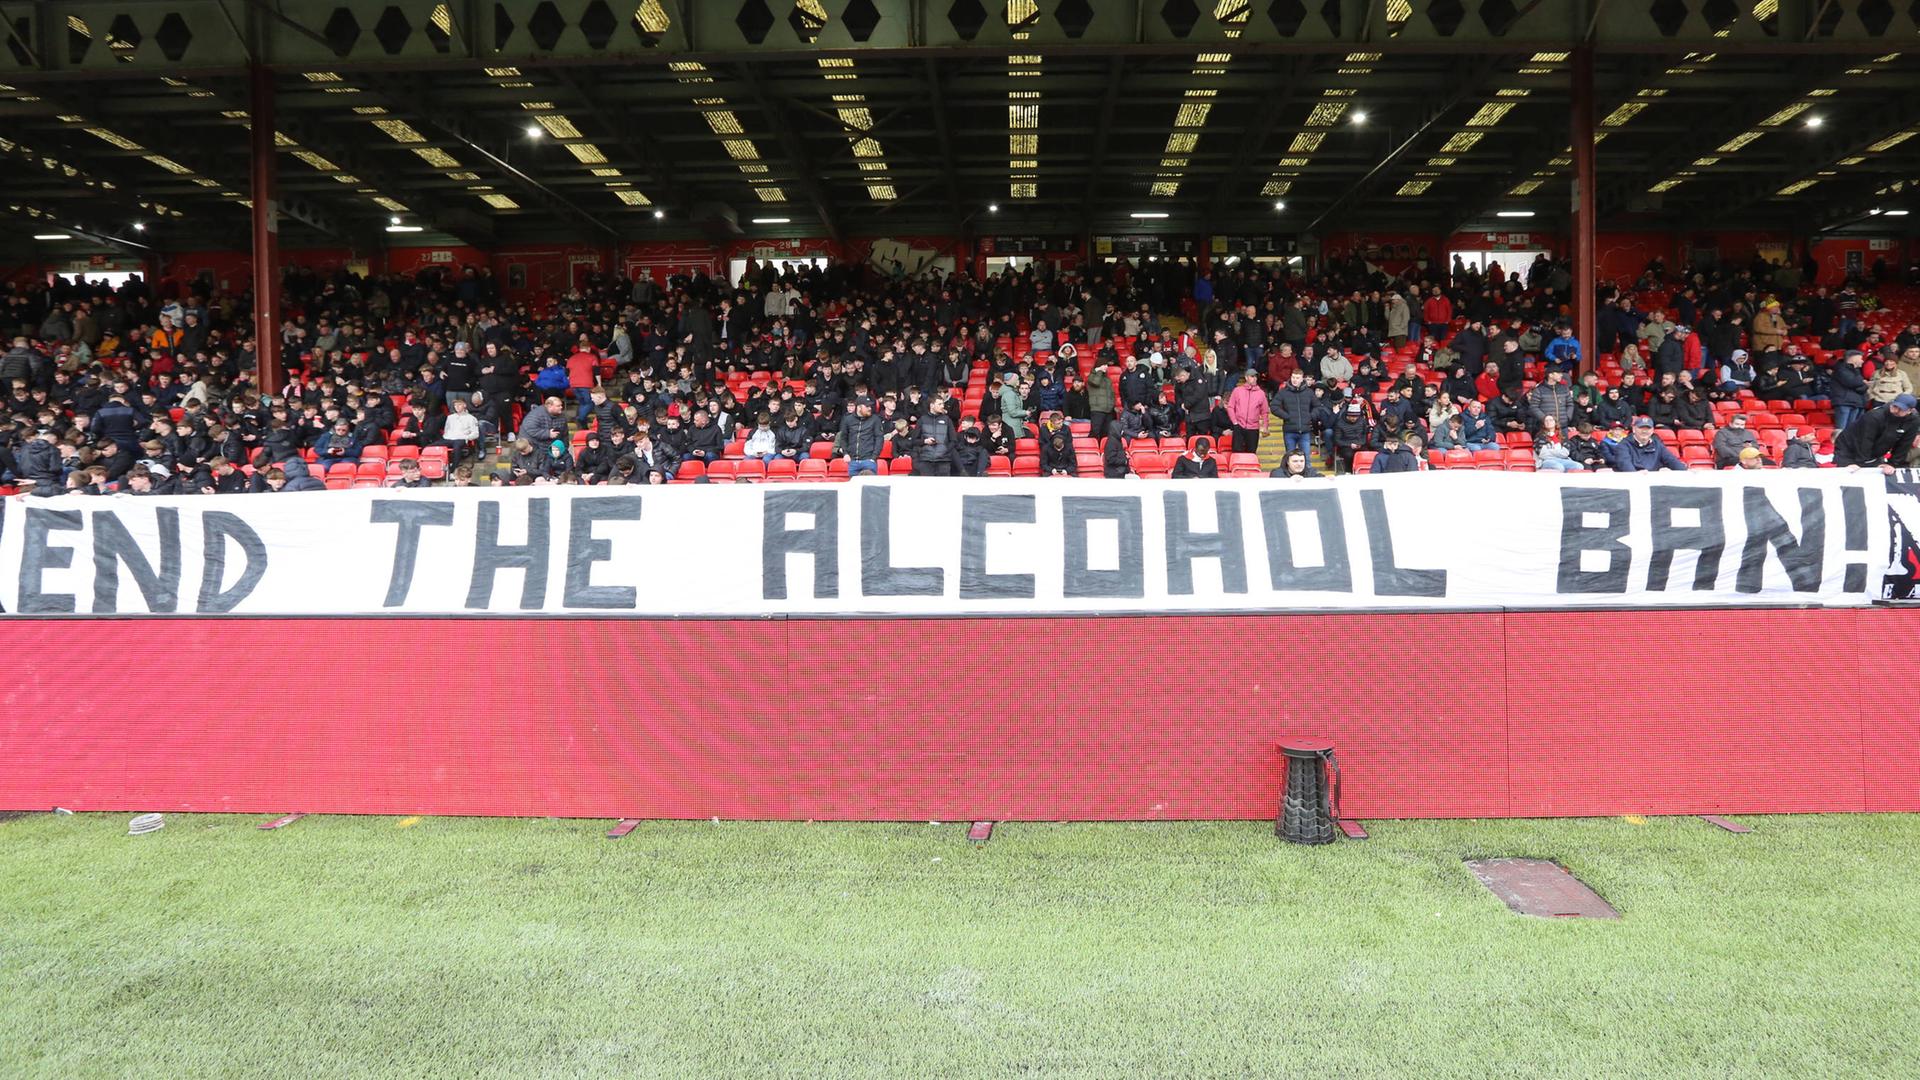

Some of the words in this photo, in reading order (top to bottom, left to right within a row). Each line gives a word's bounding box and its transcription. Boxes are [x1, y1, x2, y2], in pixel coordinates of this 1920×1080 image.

[779, 241, 791, 249] 28
[17, 506, 268, 613] END
[370, 496, 642, 610] THE
[763, 485, 1447, 600] ALCOHOL
[1556, 486, 1868, 594] BAN!
